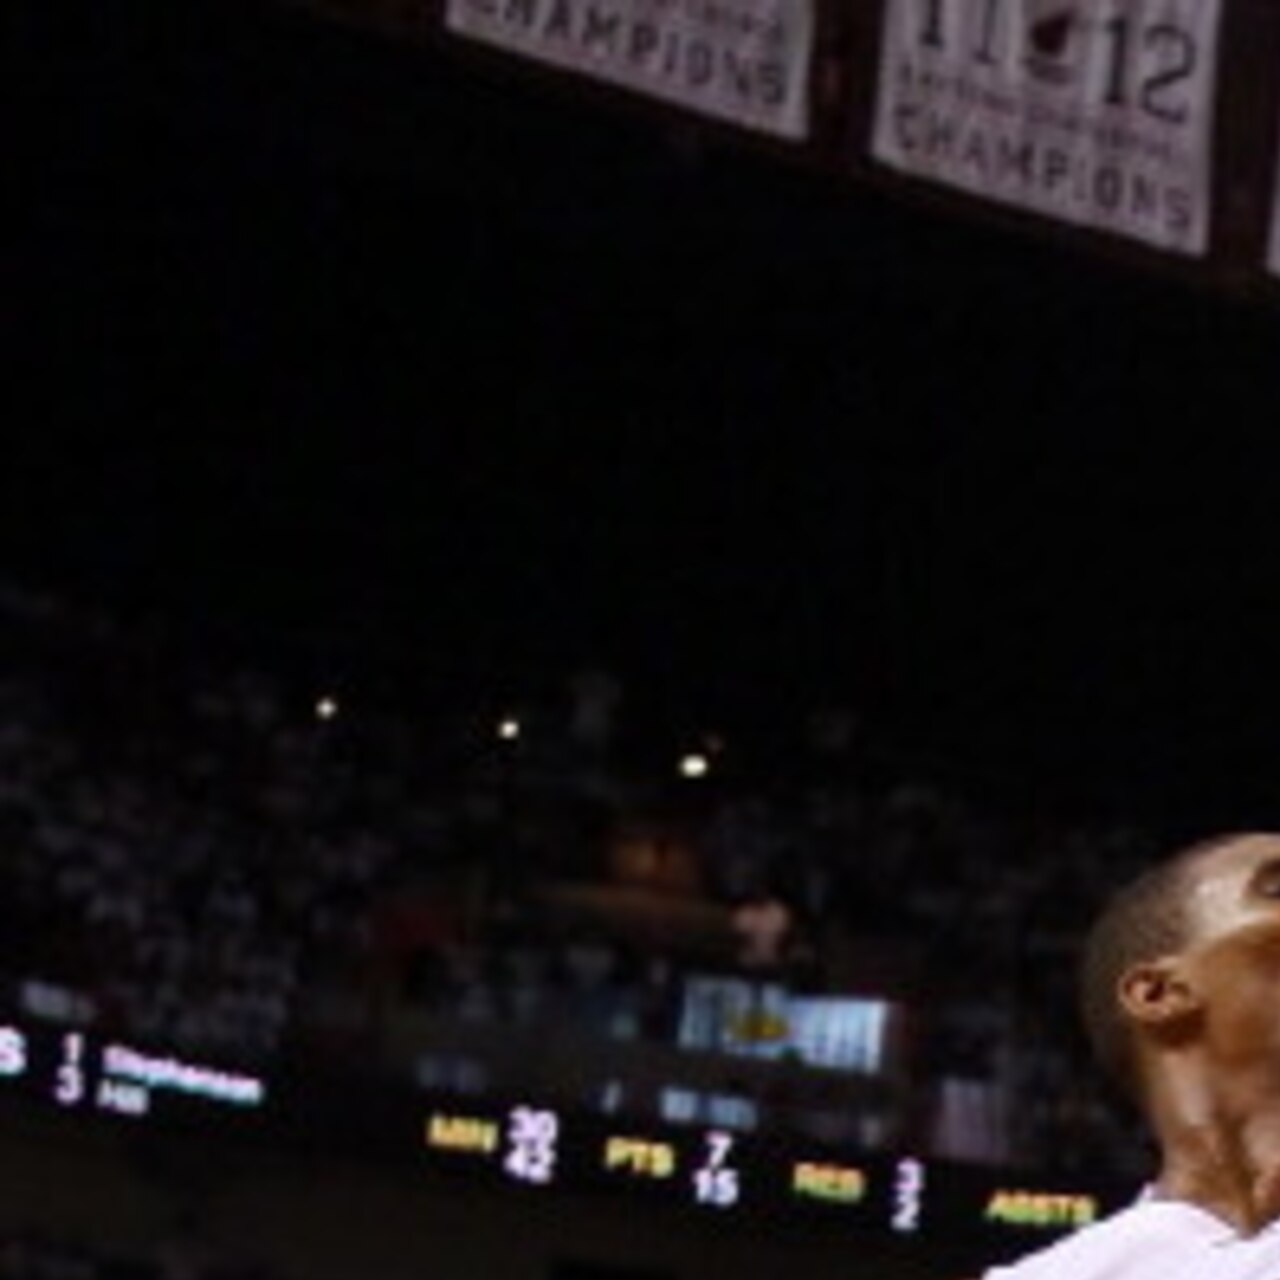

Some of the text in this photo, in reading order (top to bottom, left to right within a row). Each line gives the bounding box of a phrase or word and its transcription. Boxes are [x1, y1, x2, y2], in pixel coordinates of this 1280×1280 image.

[1098, 17, 1197, 124] 12
[893, 102, 1192, 232] CHAMPIONS
[605, 1137, 675, 1179] PTS
